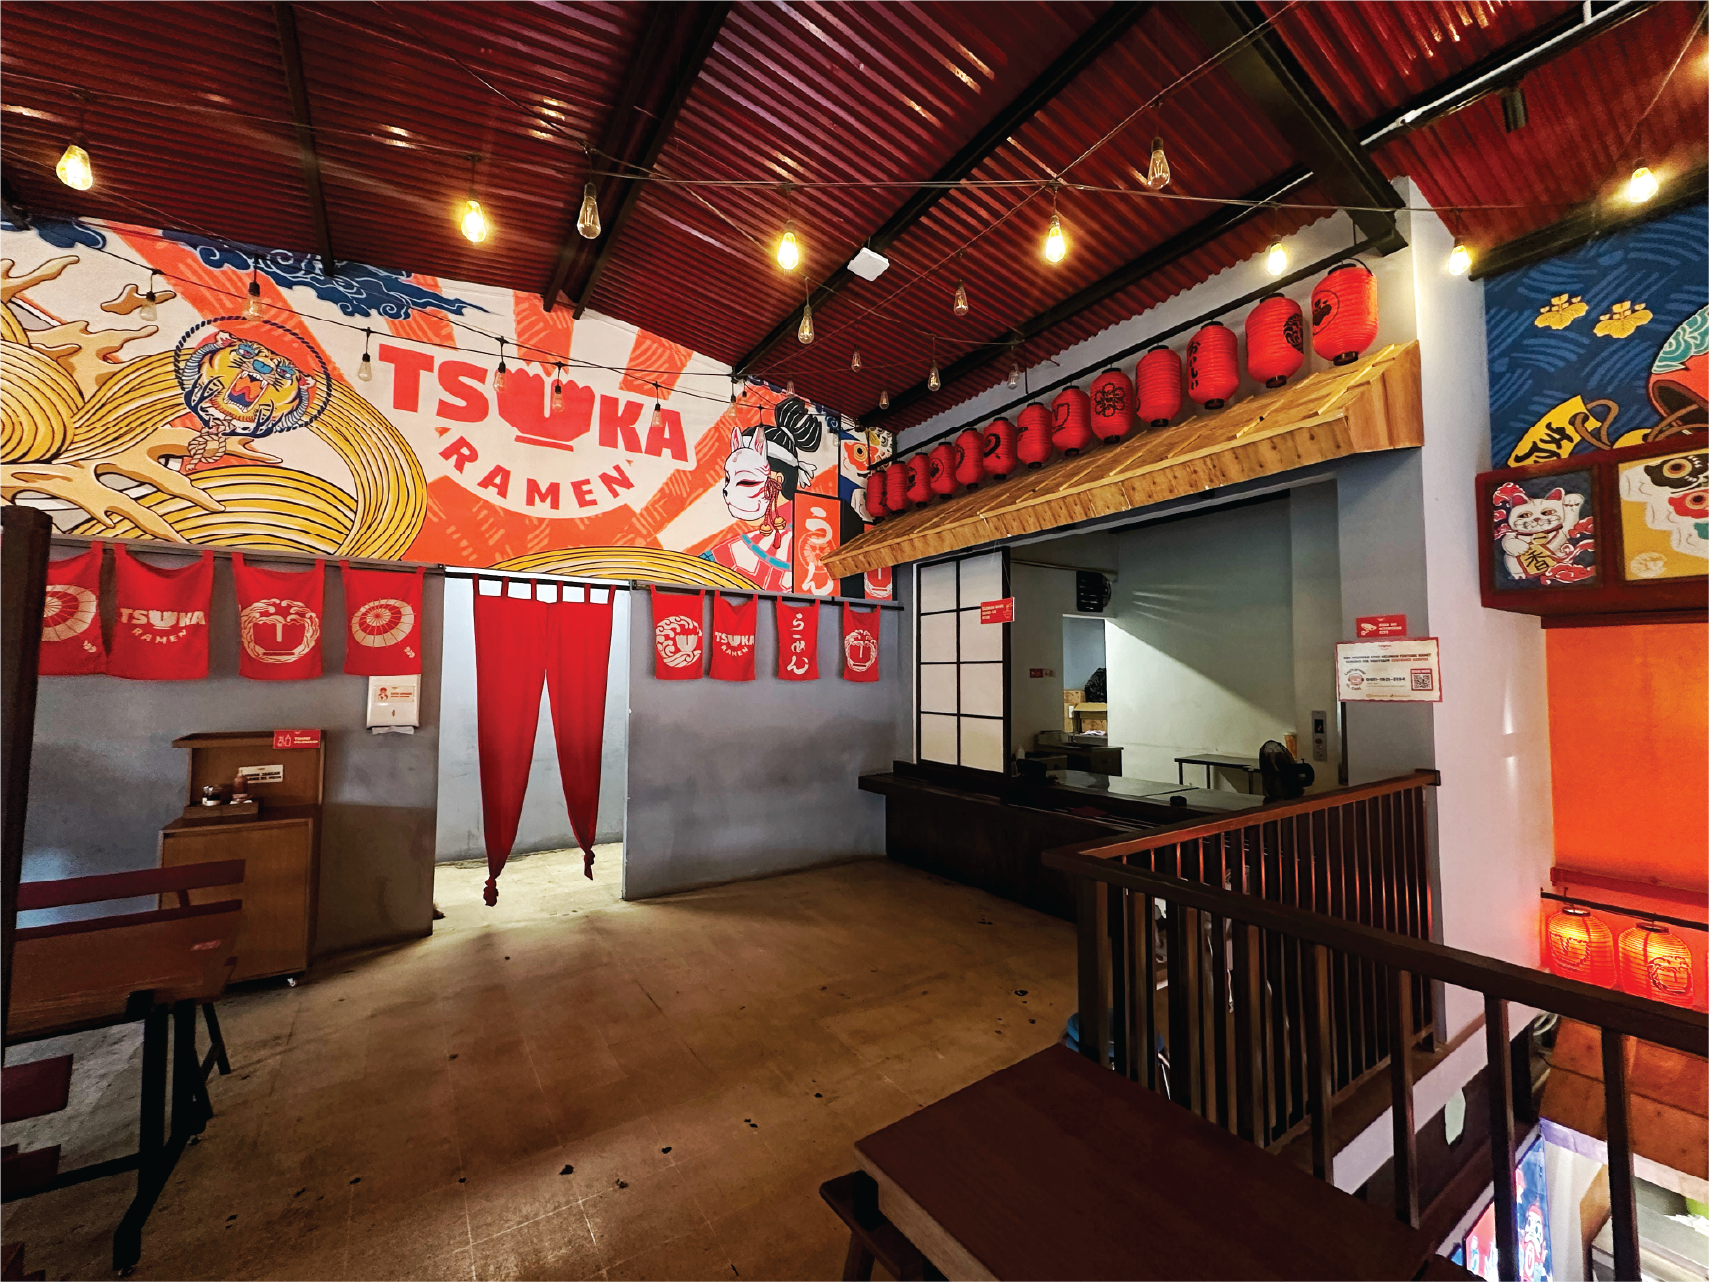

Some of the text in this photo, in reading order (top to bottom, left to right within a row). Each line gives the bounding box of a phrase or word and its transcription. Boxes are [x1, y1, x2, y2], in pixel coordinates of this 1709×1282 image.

[378, 344, 689, 462] TSUKA
[438, 435, 635, 510] RAMEN
[119, 607, 206, 630] TSUKA
[131, 627, 188, 645] RAMEN
[715, 631, 755, 647] TSUKA
[786, 612, 809, 675] らーめん
[721, 645, 749, 657] RAMEN
